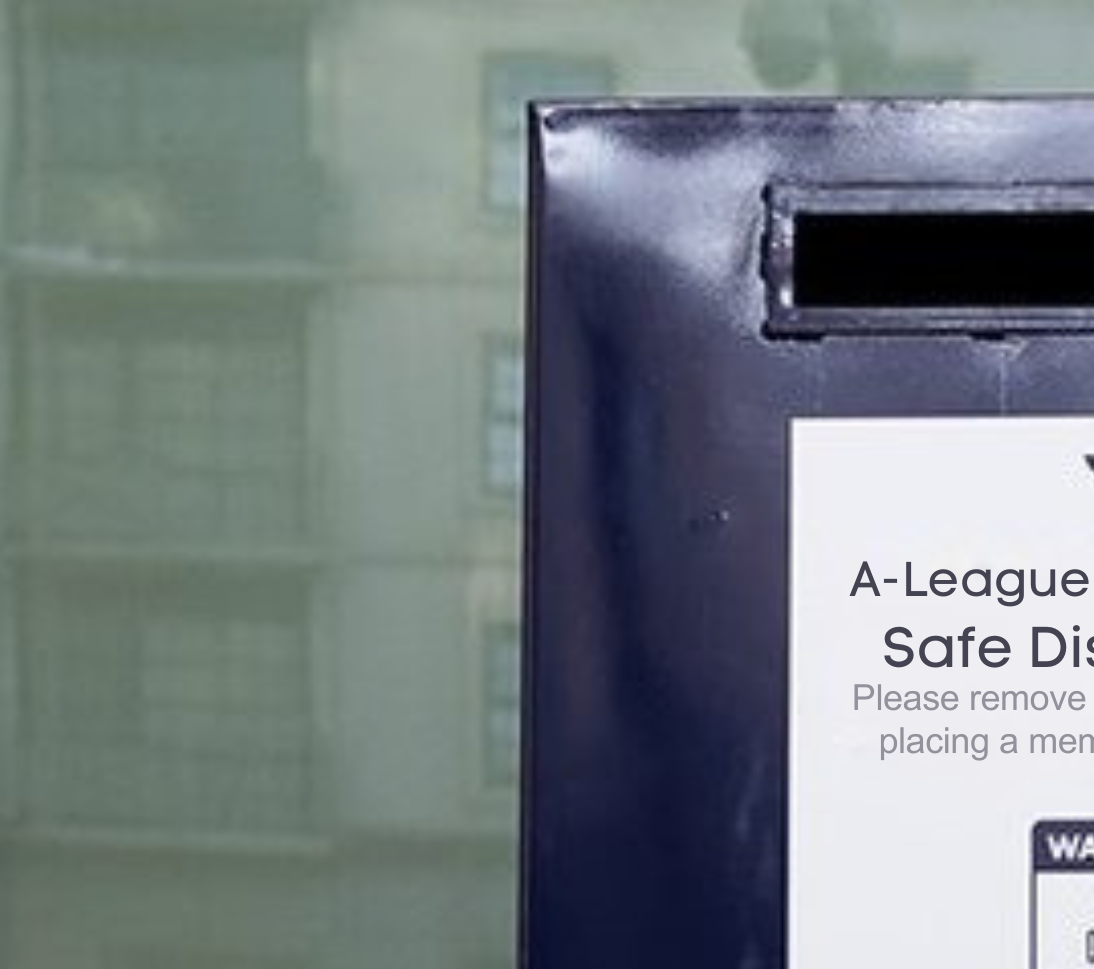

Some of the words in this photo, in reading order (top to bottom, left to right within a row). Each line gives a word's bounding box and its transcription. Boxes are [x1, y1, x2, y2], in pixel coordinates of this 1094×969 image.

[850, 561, 1089, 607] A-League
[884, 625, 1011, 668] Safe
[854, 684, 959, 711] Please
[971, 691, 1086, 711] remove
[880, 727, 989, 761] placing
[1000, 734, 1018, 754] a
